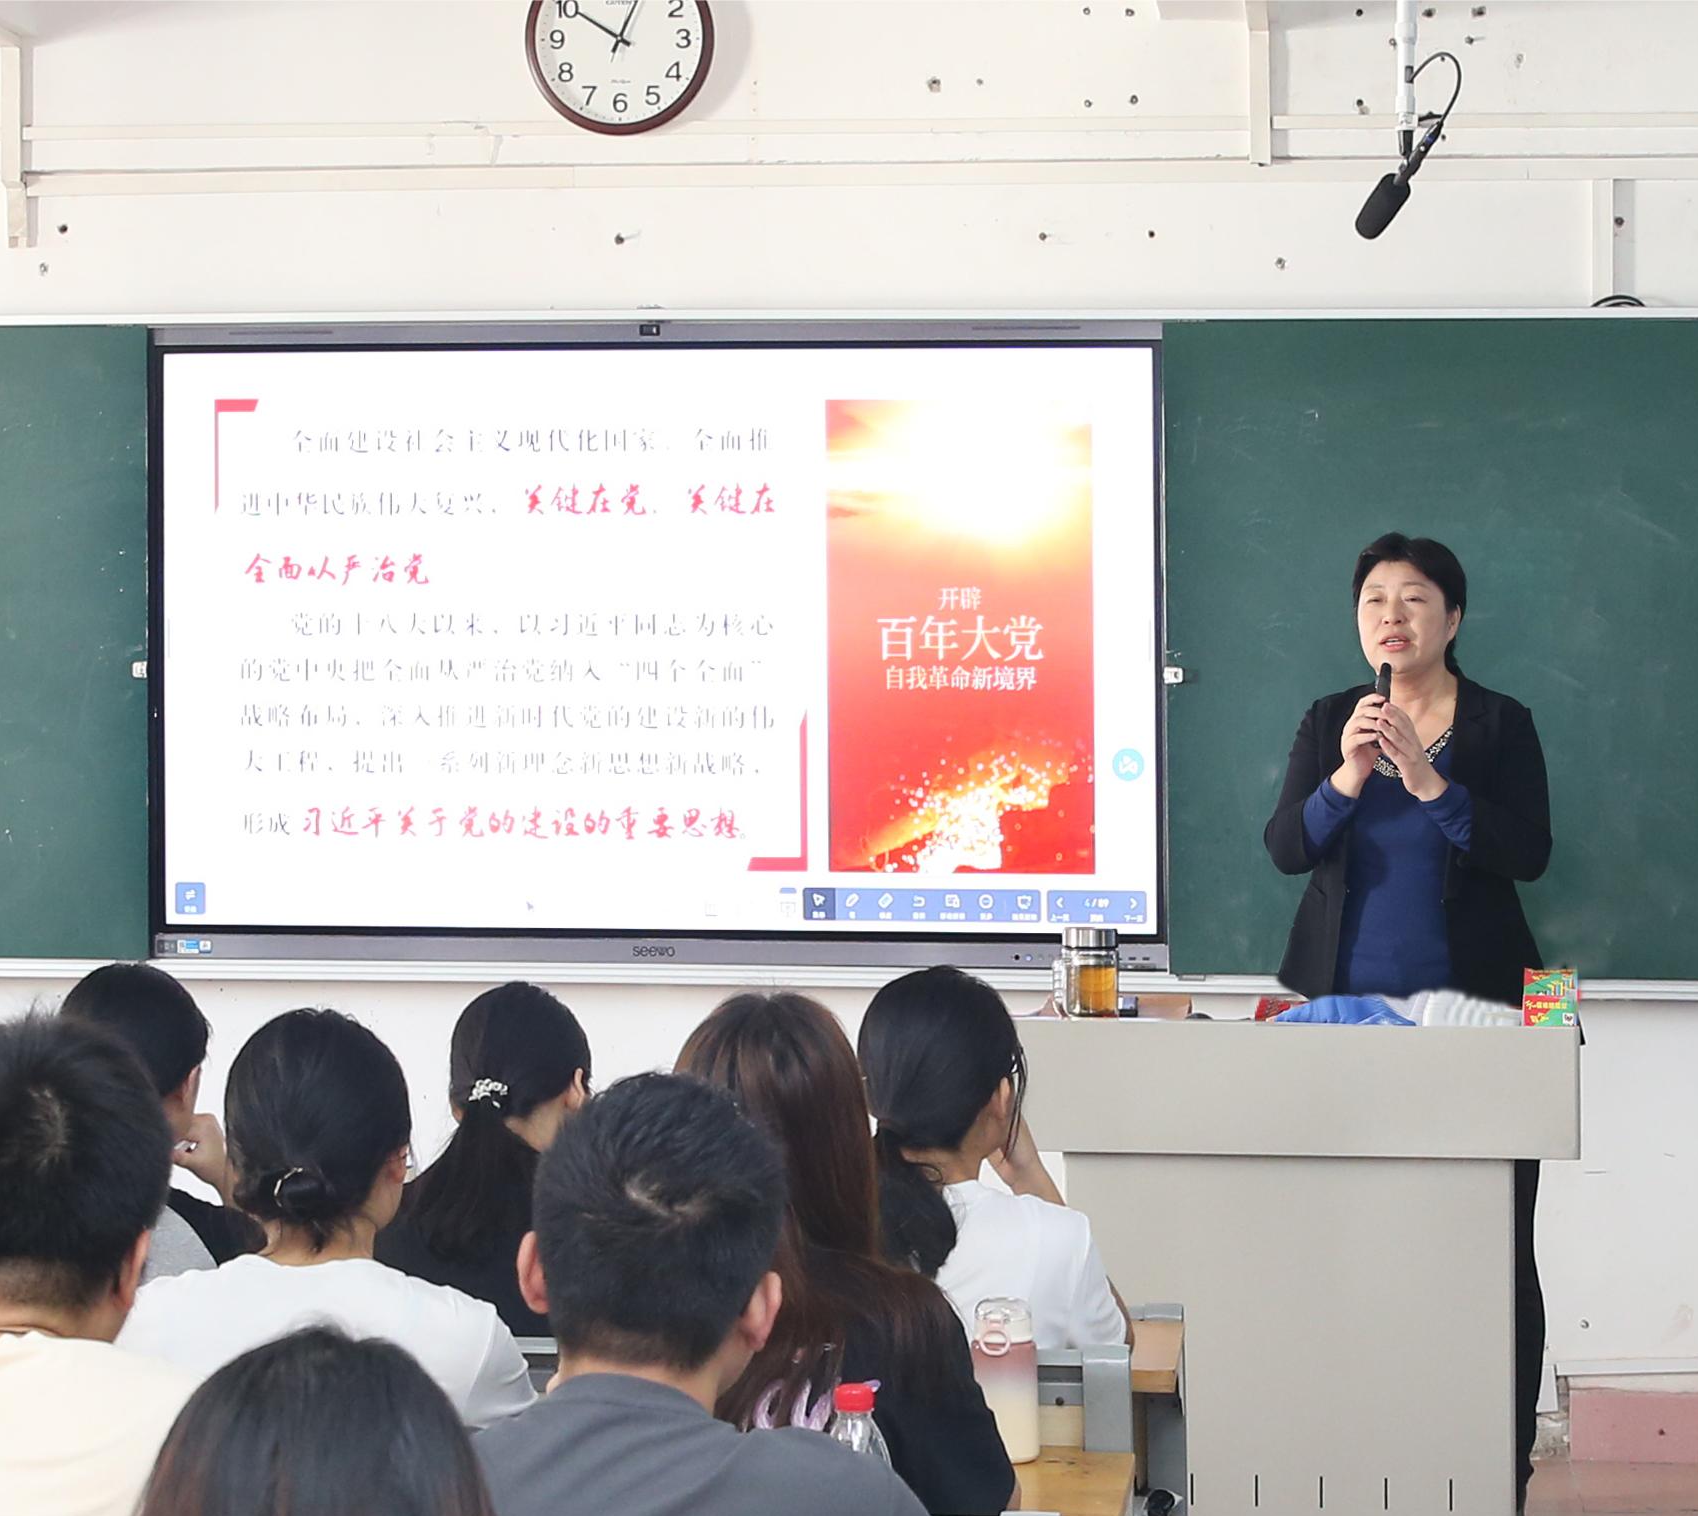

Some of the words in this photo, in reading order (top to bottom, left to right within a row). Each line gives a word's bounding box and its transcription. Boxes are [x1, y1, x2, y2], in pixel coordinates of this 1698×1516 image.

[549, 29, 565, 49] 9
[675, 28, 691, 48] 3
[558, 62, 574, 82] 8
[665, 61, 682, 82] 4
[582, 85, 597, 106] 7
[612, 92, 628, 113] 6
[645, 85, 661, 105] 5
[938, 586, 982, 611] 开辟
[877, 614, 1044, 662] 百年大党
[886, 665, 1038, 691] 自我革命新境界
[632, 946, 676, 957] seewo
